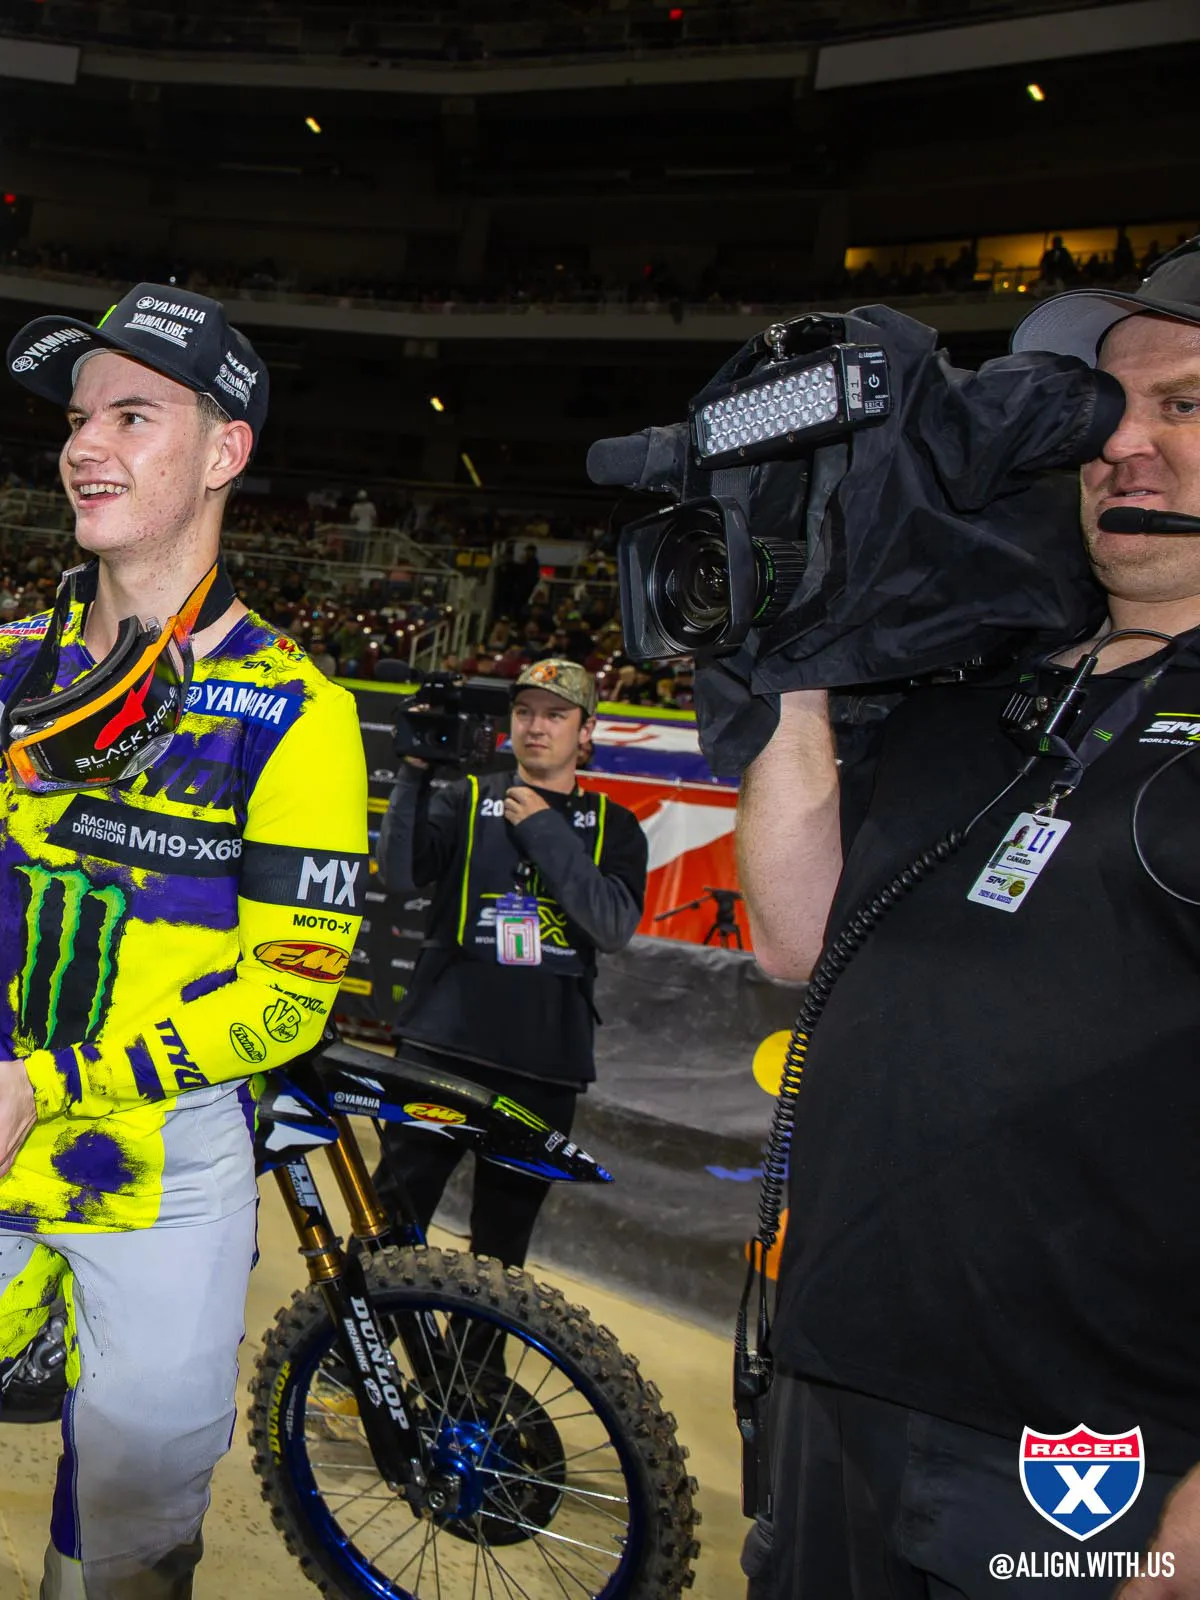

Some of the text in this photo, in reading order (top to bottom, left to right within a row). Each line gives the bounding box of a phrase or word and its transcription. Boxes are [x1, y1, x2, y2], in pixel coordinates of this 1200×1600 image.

[151, 300, 206, 324] YAMAHA
[23, 328, 89, 358] YAMAHA
[205, 684, 288, 725] YAMAHA
[75, 730, 144, 769] BLACK
[480, 798, 505, 817] 20
[573, 811, 596, 828] 26
[72, 822, 126, 846] DIVISION
[80, 813, 127, 835] RACING
[128, 825, 242, 861] M19-X68
[1027, 827, 1057, 854] L1
[297, 856, 360, 908] MX
[292, 914, 352, 934] MOTO-X
[345, 1094, 380, 1109] YAMAHA
[404, 1104, 466, 1123] FMF
[343, 1317, 371, 1373] BRAKING
[350, 1296, 410, 1430] DUNLOP
[268, 1361, 291, 1454] DUNLOP
